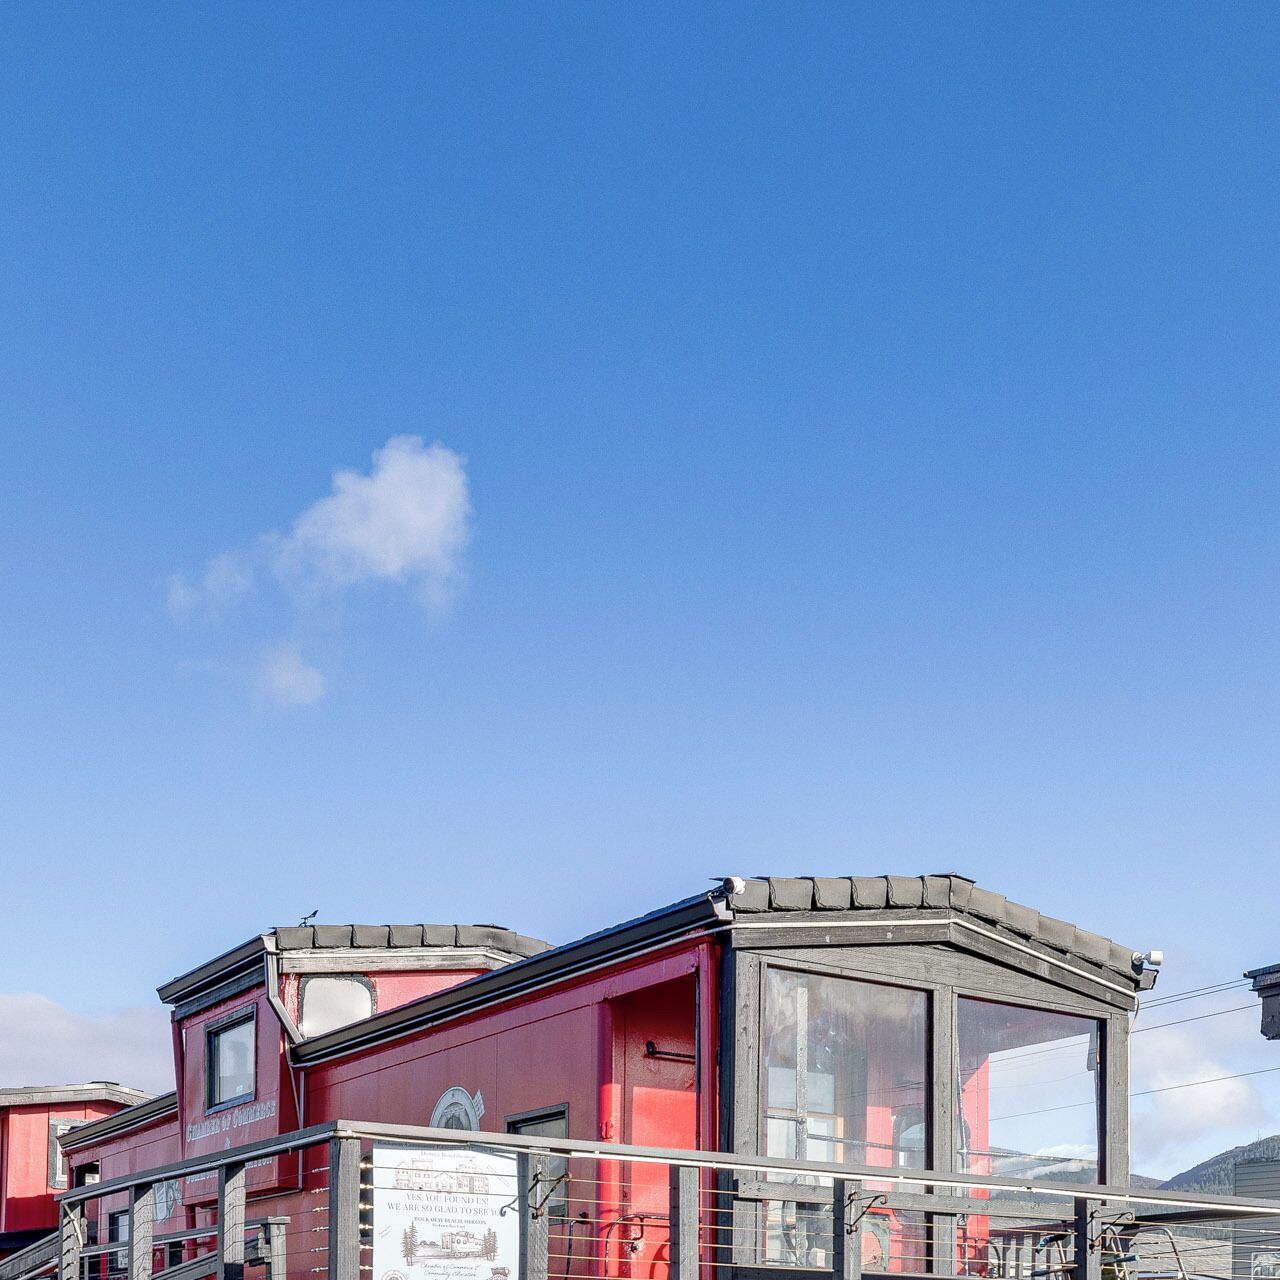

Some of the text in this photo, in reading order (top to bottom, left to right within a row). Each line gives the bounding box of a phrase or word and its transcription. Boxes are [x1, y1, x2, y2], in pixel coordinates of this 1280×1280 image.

[221, 1113, 232, 1131] OF
[425, 1193, 440, 1202] YOU
[444, 1194, 475, 1204] FOUND
[387, 1202, 401, 1211] WE
[403, 1203, 420, 1211] ARE
[421, 1204, 433, 1212] SO
[434, 1205, 458, 1214] GLAD
[473, 1207, 489, 1216] SEE
